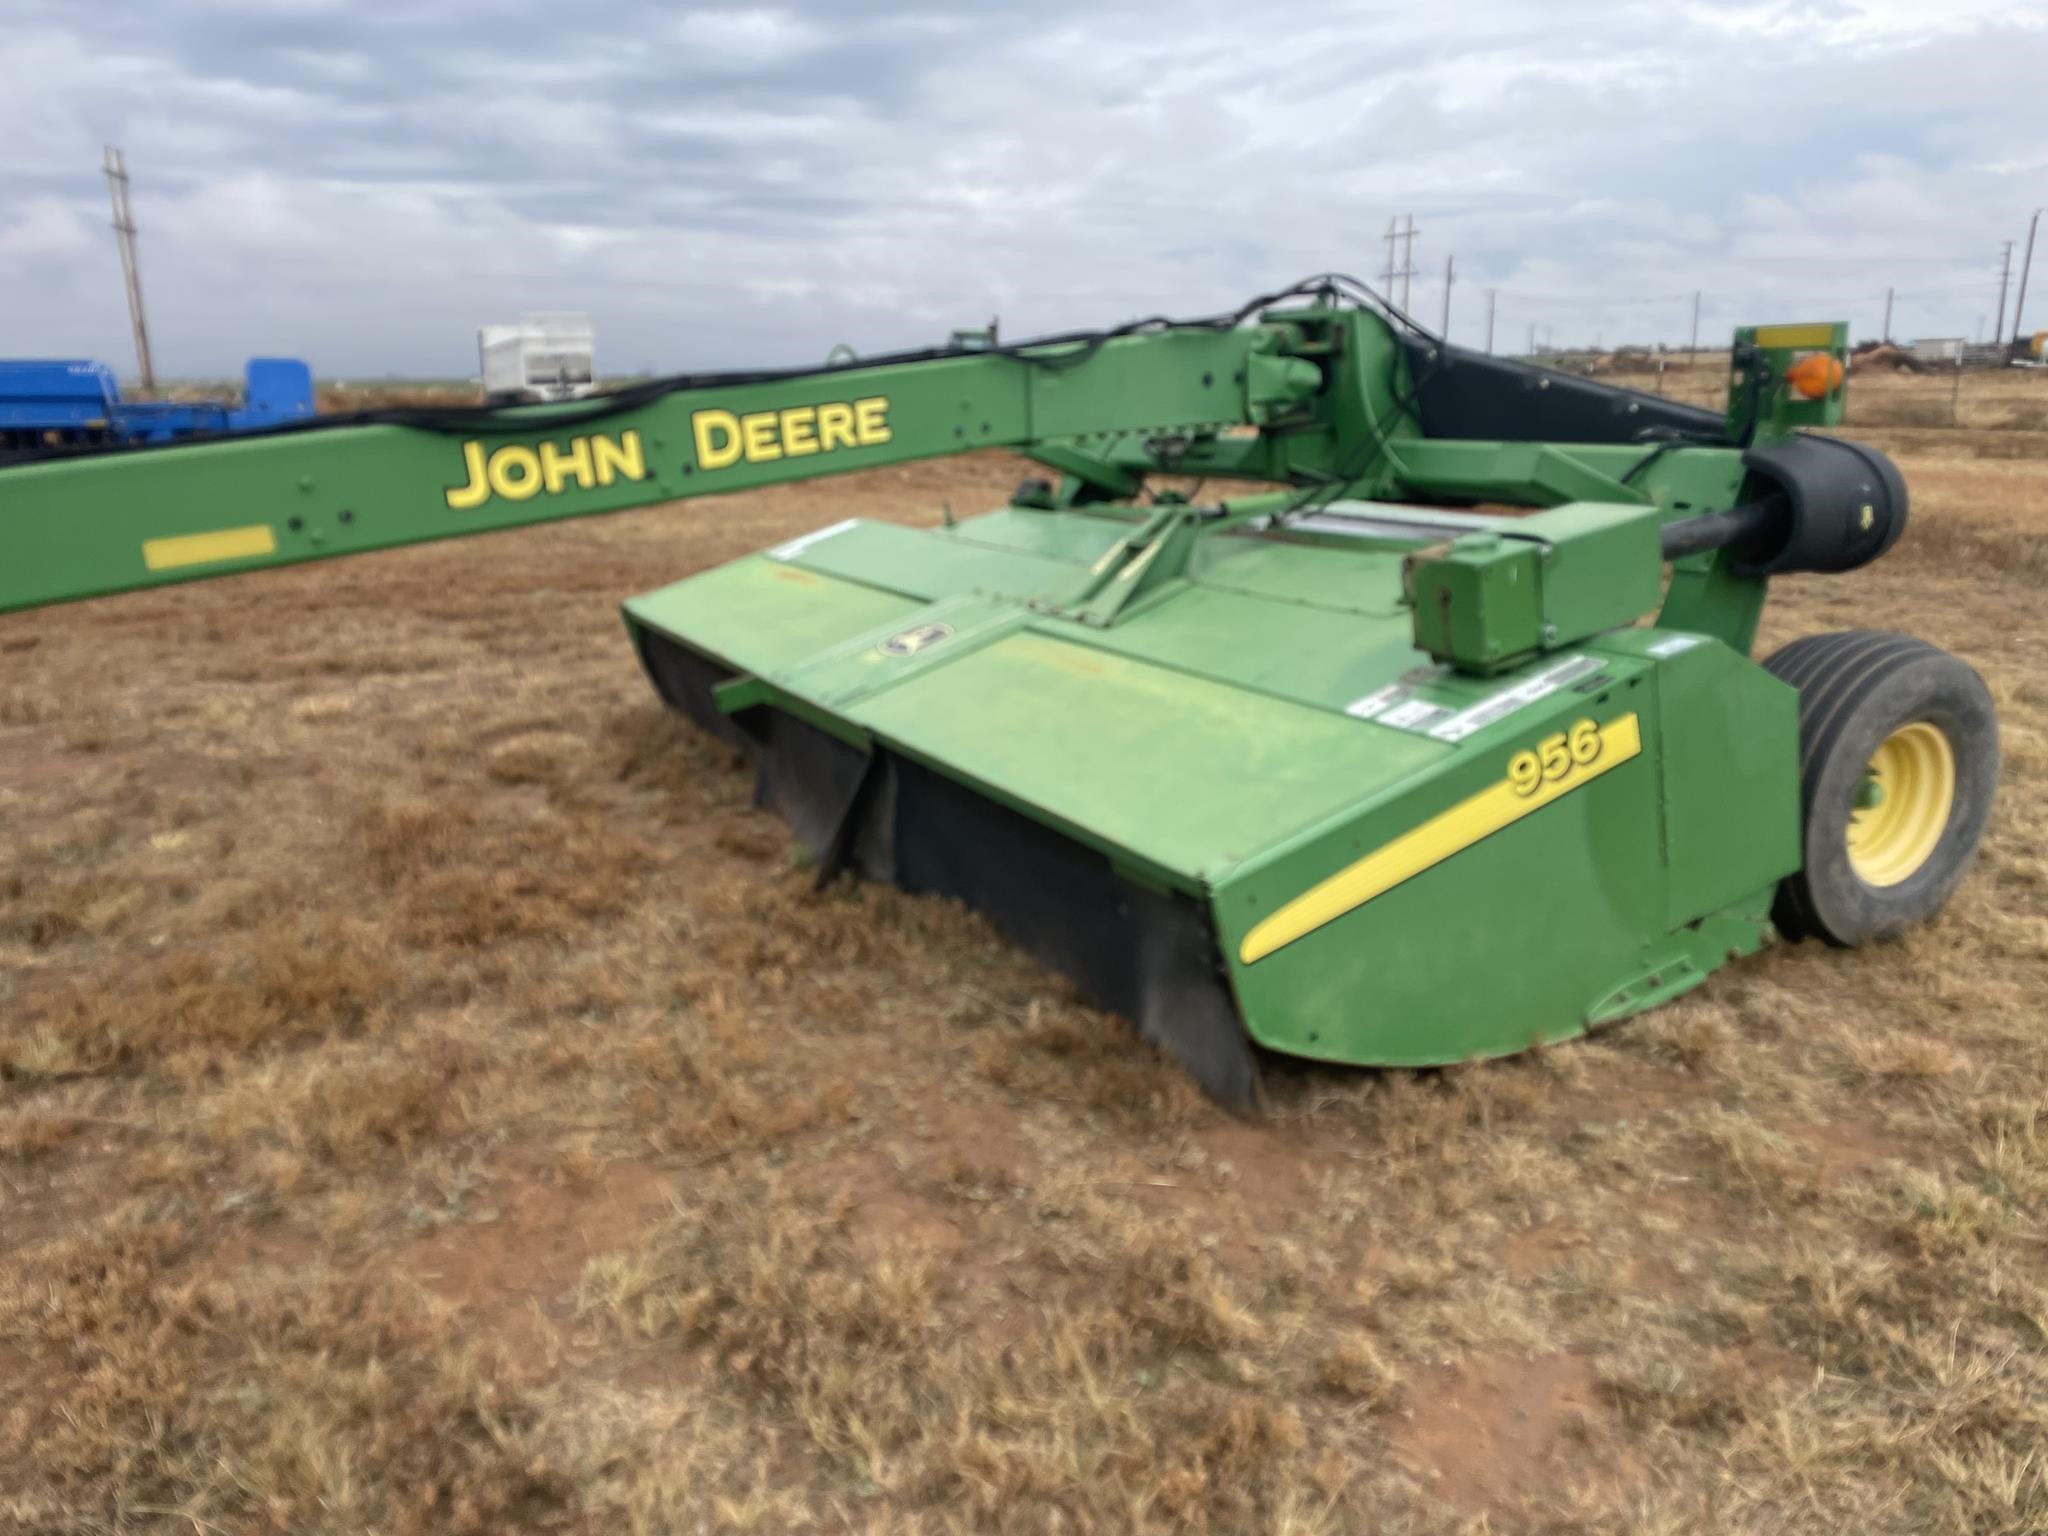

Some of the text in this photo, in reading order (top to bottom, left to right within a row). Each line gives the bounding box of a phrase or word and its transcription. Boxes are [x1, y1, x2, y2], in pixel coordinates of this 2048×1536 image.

[446, 396, 891, 509] JOHN DEERE
[1508, 717, 1602, 797] 956
